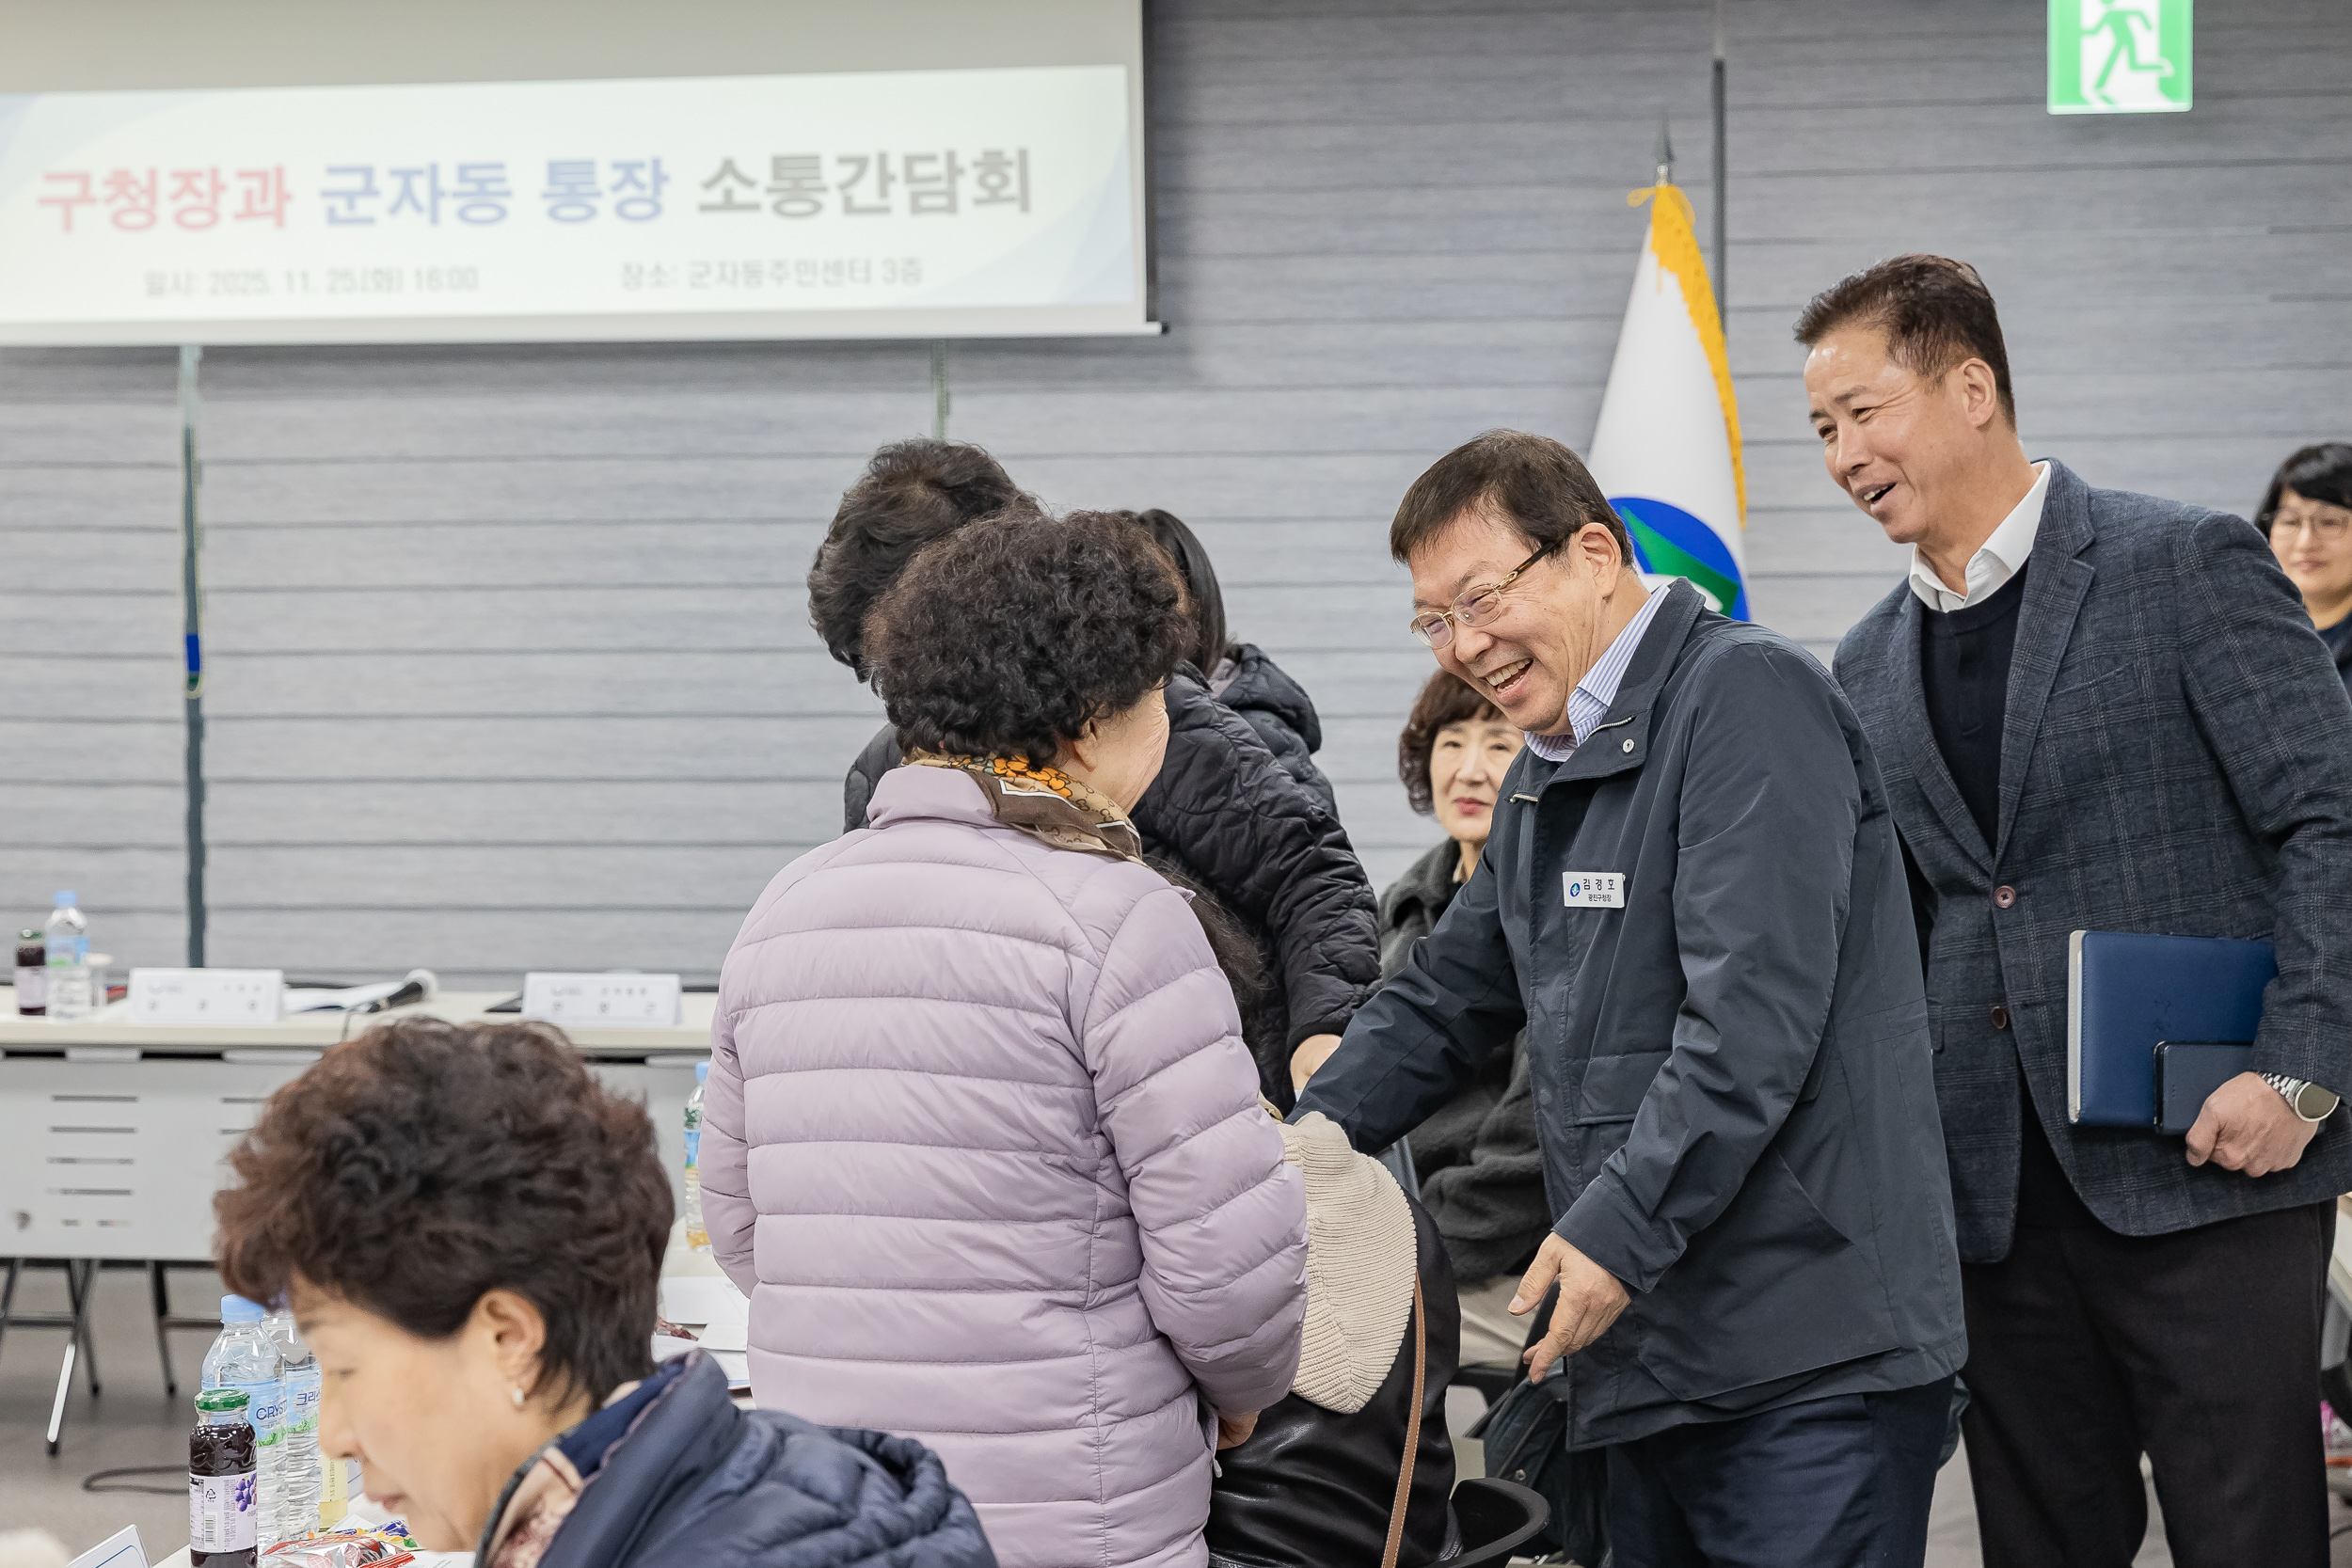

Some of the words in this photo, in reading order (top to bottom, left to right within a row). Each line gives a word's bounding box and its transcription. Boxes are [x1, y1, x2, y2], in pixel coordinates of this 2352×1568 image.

[37, 165, 294, 232] 구청장과
[319, 162, 514, 226] 군자동
[541, 156, 670, 224] 통장
[697, 149, 1032, 219] 소통간담회
[689, 258, 872, 289] 군자동주민센터
